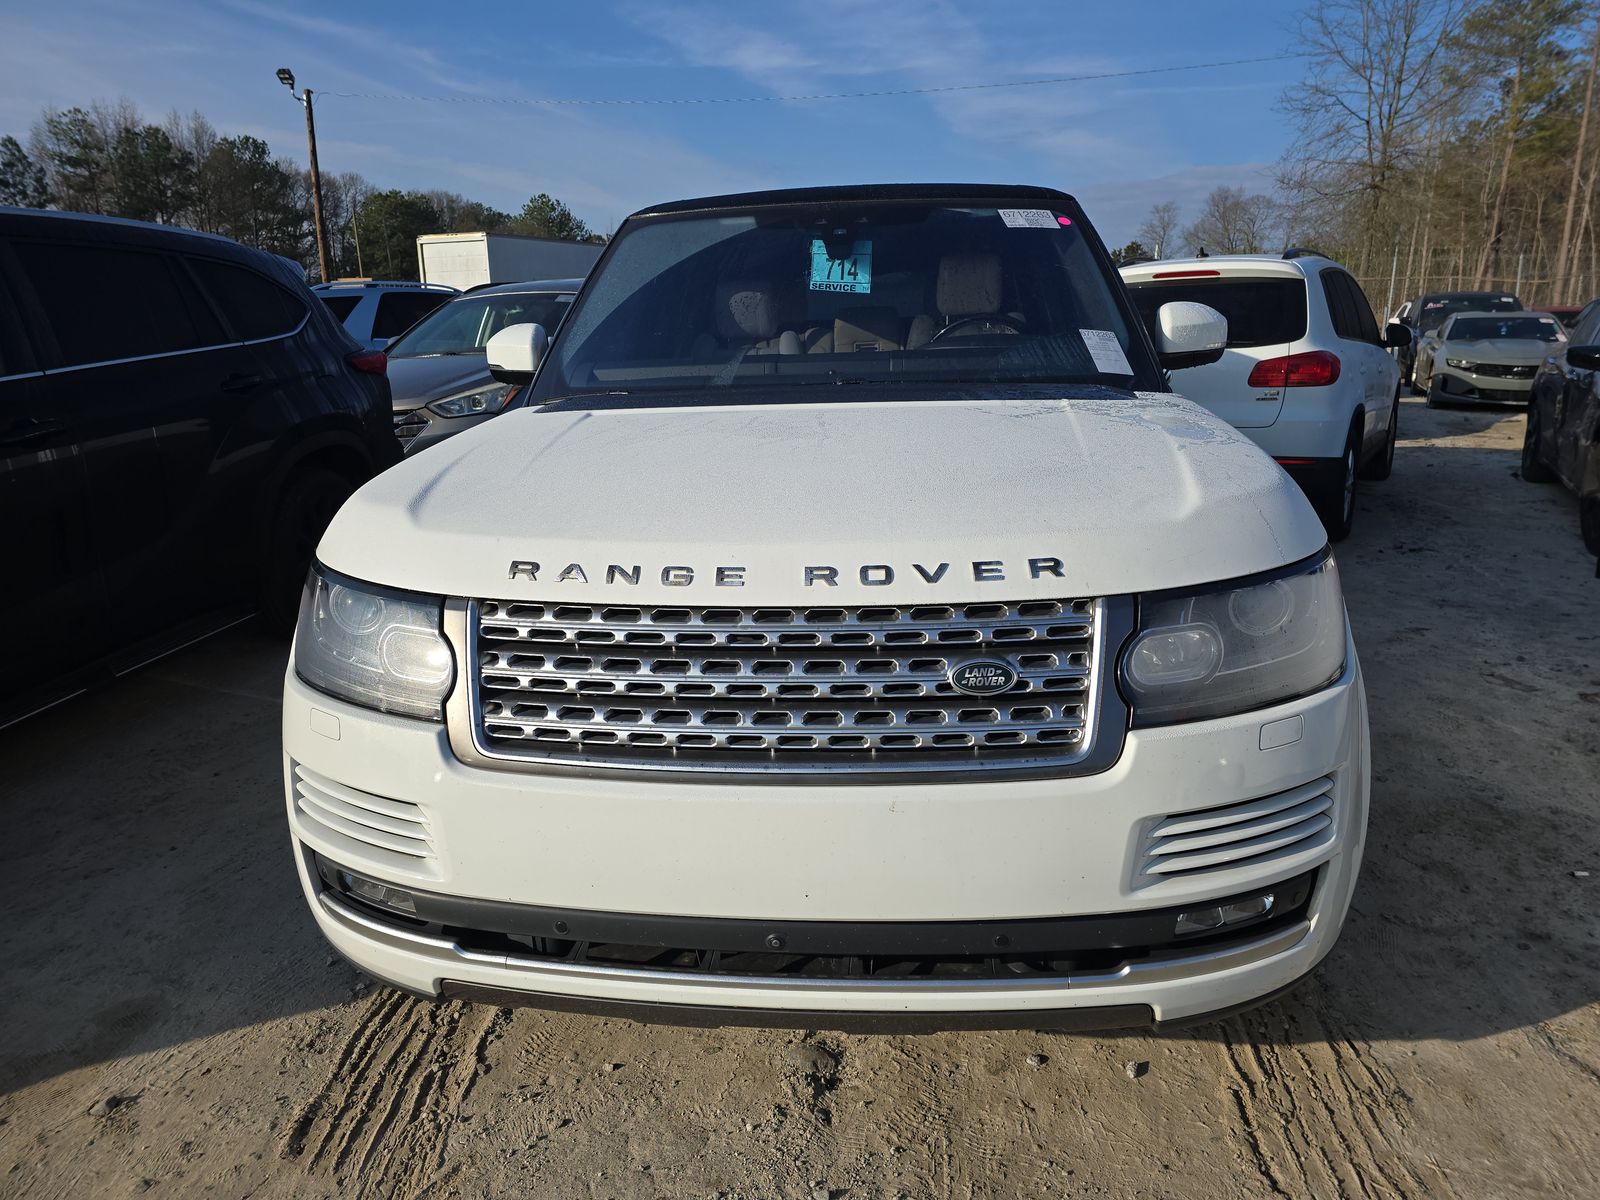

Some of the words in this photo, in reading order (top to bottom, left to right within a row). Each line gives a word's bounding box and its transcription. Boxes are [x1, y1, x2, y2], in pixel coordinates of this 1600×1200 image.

[1003, 210, 1051, 219] 6712263
[826, 258, 858, 281] 714
[811, 282, 857, 292] SERVICE
[508, 560, 747, 586] RANGE
[805, 557, 1066, 587] ROVER
[964, 667, 995, 678] LAND
[968, 676, 1005, 687] ROVER
